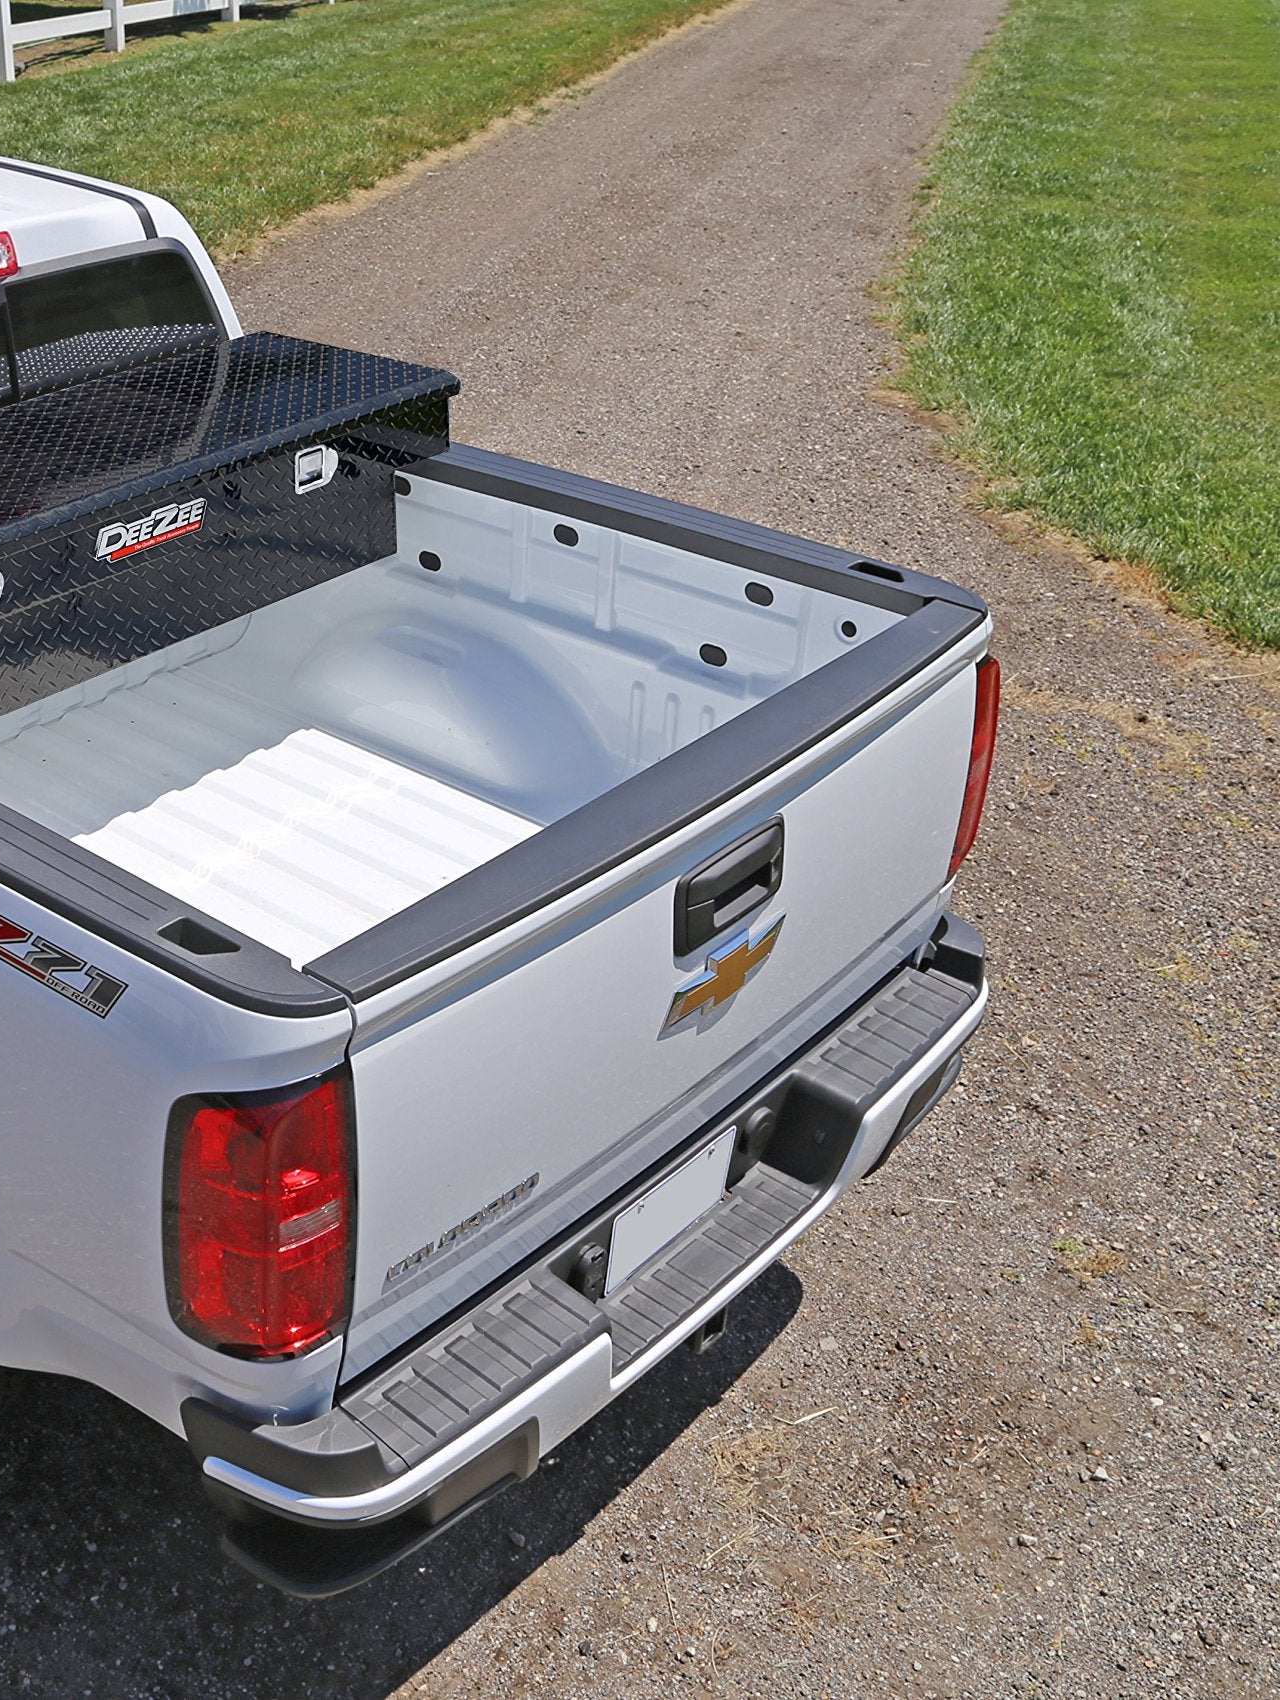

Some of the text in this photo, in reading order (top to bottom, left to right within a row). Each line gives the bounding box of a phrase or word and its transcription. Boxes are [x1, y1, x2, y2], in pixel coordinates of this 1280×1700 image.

[46, 976, 106, 1014] OFF ROAD
[386, 1172, 540, 1282] COLORADO
